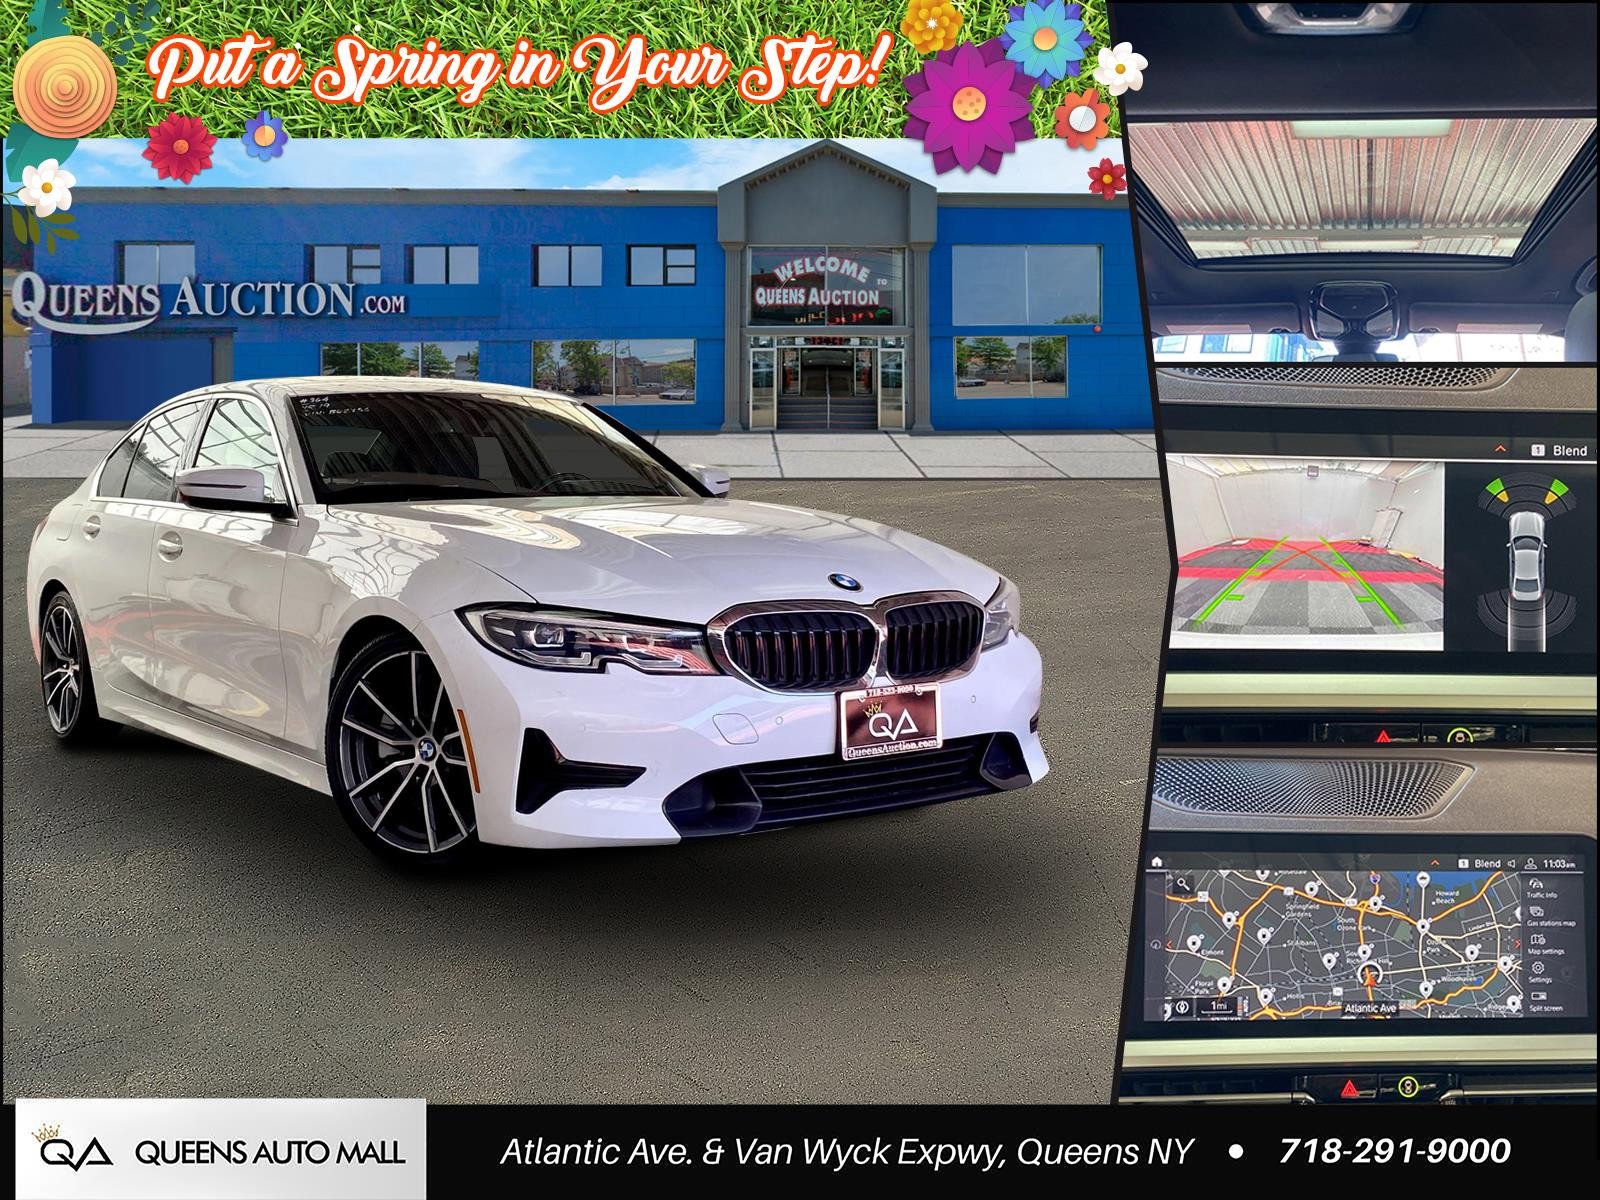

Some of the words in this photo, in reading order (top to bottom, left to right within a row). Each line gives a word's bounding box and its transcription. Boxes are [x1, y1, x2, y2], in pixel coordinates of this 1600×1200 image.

[773, 256, 871, 284] WELCOME
[11, 270, 161, 335] QUEENS
[755, 287, 806, 305] QUEENS
[807, 287, 880, 306] AUCTION
[1553, 444, 1588, 456] Blend
[847, 739, 938, 759] QueensAuction.com
[1475, 859, 1501, 868] Blend
[1528, 976, 1553, 984] Settings
[1344, 1003, 1379, 1013] Atlantic
[1380, 1003, 1397, 1013] Ave
